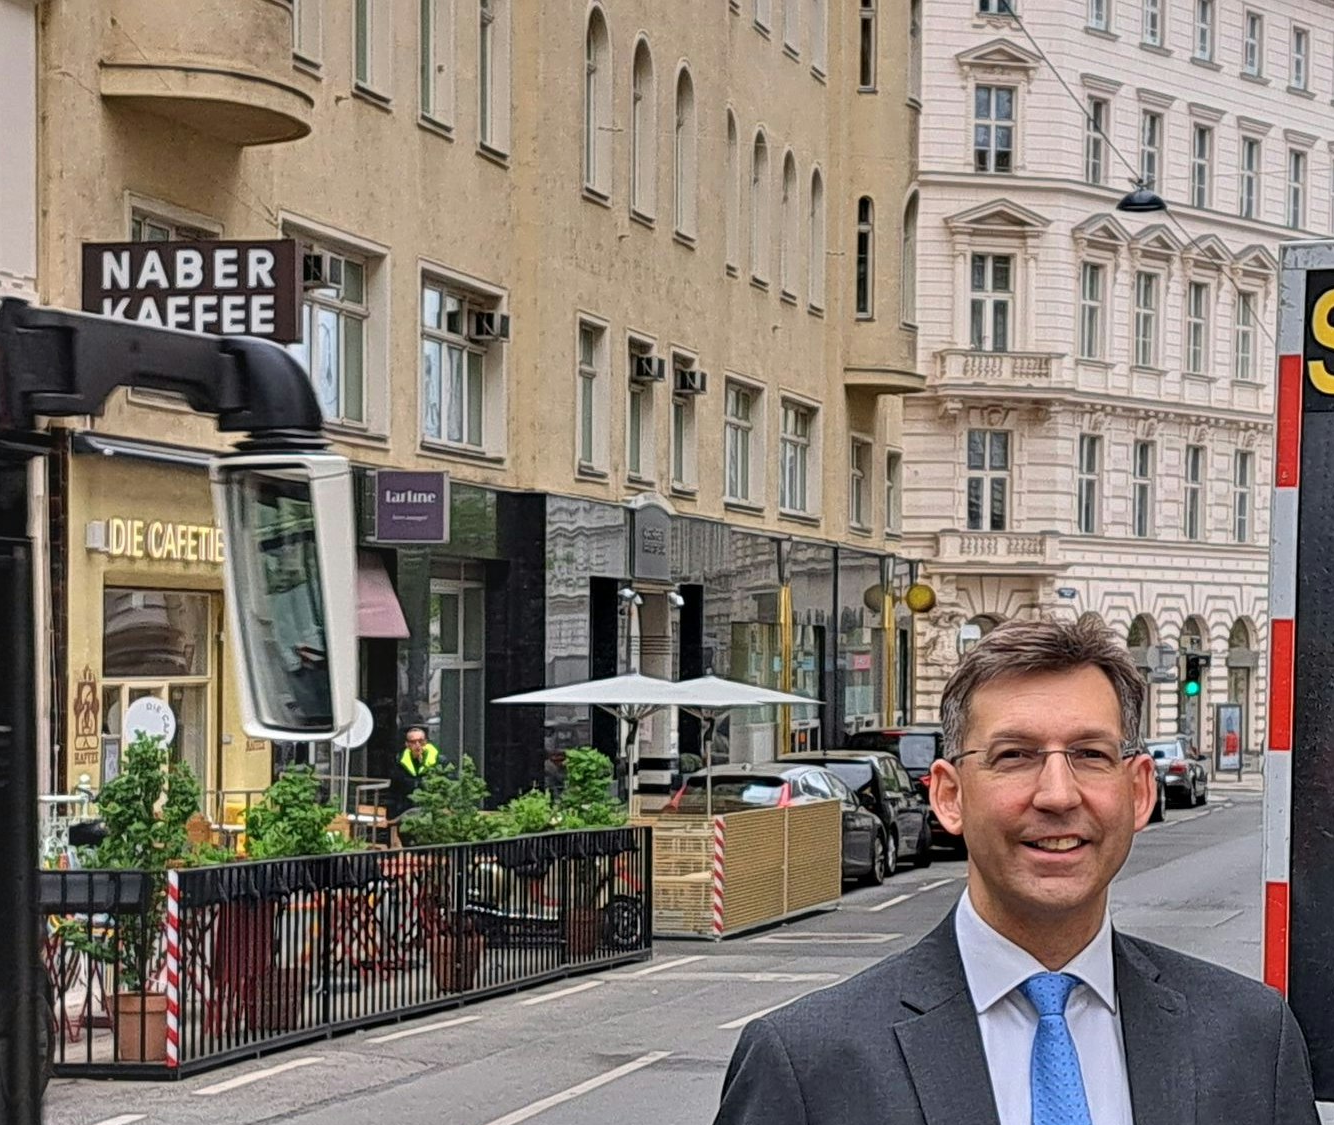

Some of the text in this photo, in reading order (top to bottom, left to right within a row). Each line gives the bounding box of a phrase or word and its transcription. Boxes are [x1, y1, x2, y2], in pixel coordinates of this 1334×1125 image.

[101, 249, 276, 290] NABER
[102, 294, 275, 334] KAFFEE
[108, 518, 144, 557] DIE
